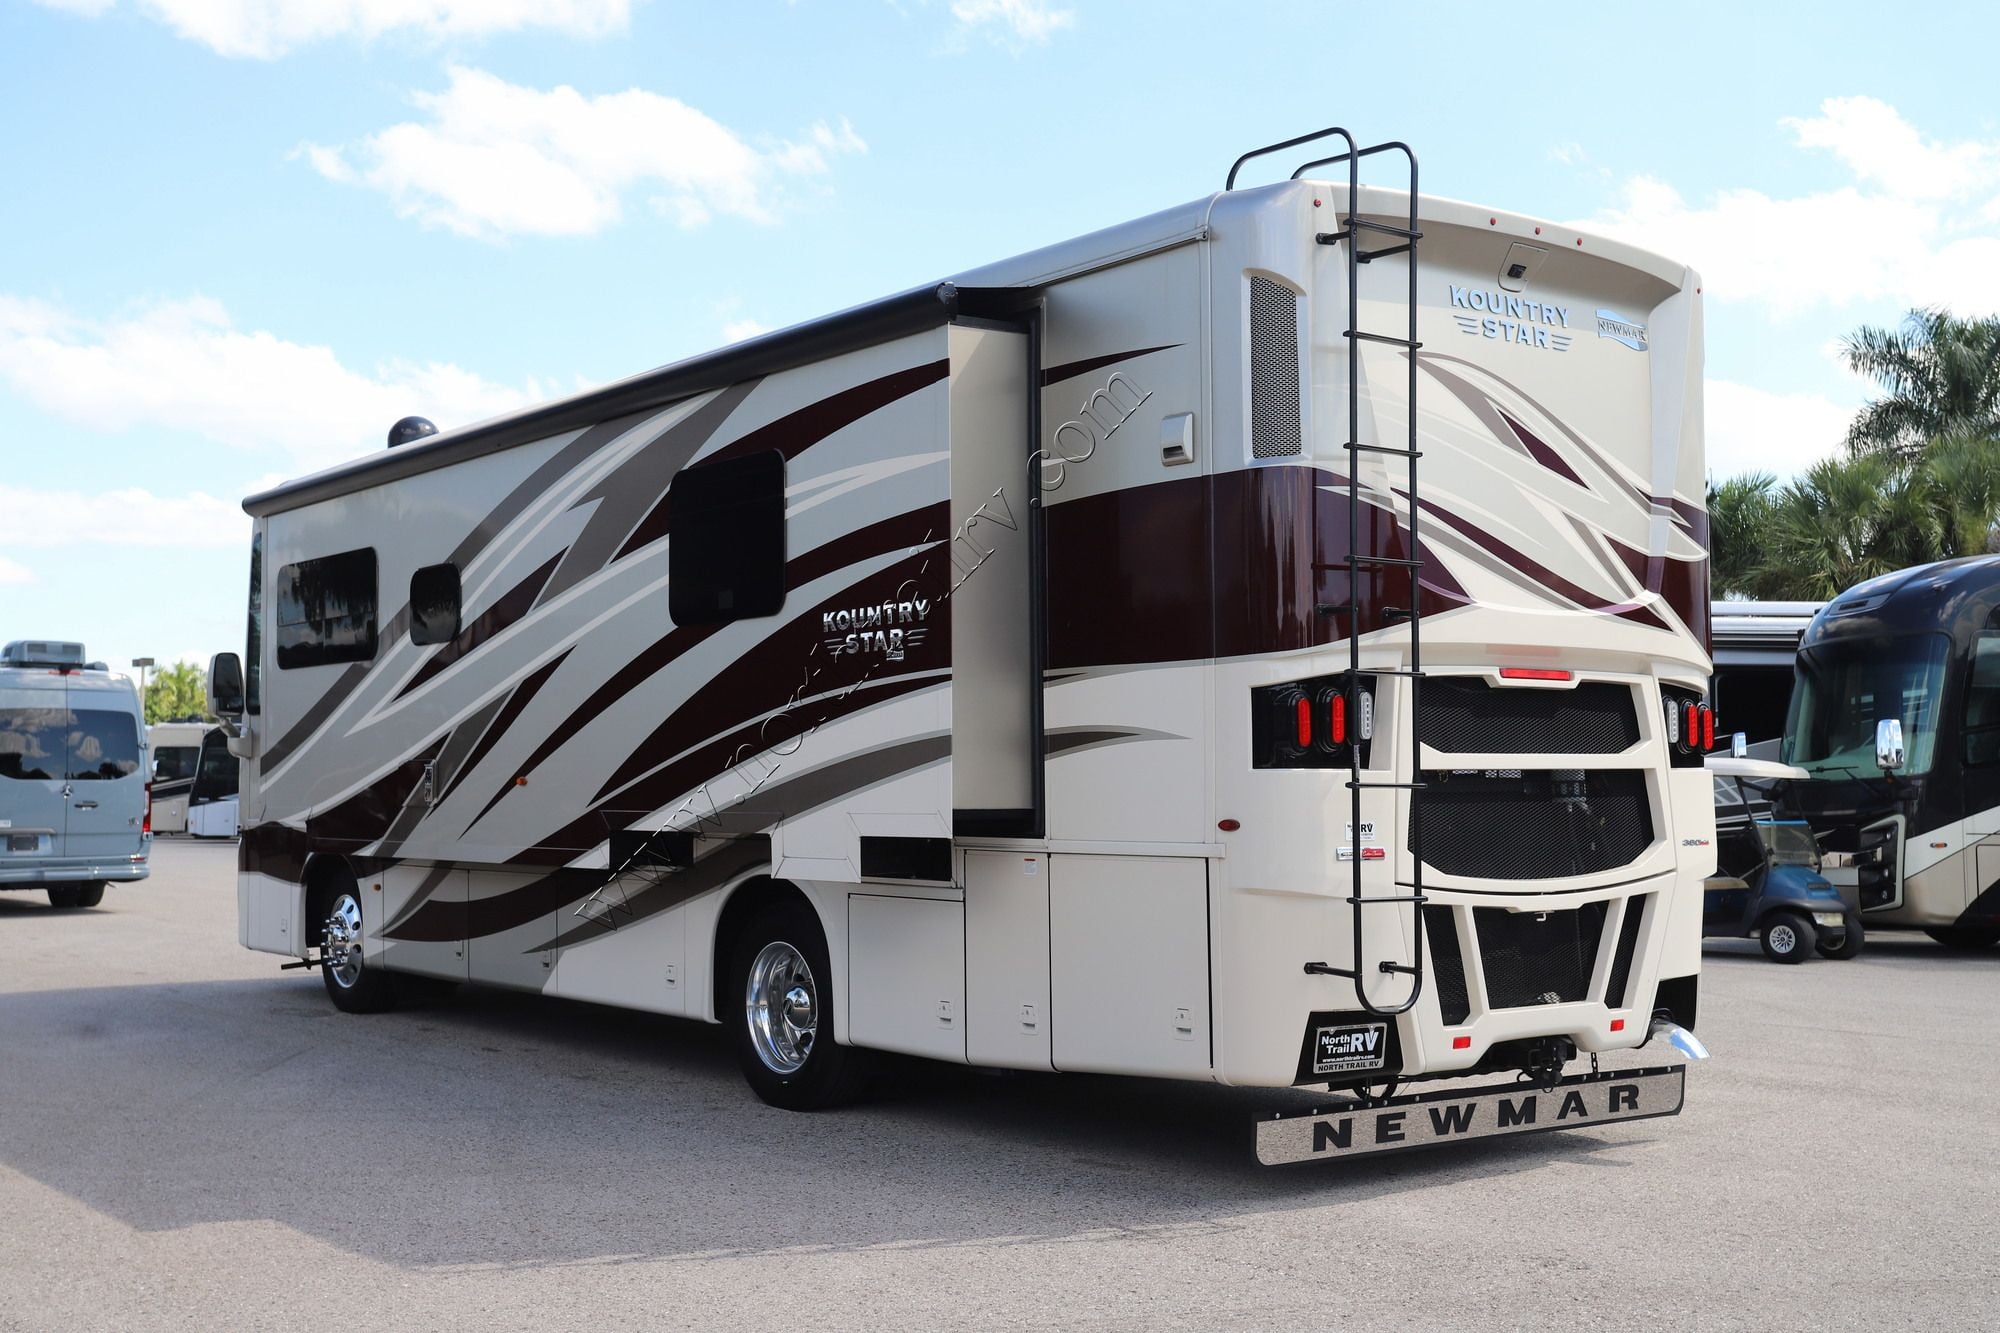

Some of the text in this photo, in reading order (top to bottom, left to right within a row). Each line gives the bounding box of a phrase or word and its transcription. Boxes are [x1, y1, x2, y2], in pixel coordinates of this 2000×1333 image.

[1450, 284, 1569, 328] KOUNTRY
[1482, 316, 1549, 349] STAR
[1599, 320, 1647, 342] NEWMAR
[823, 599, 929, 633] KOUNTRY
[845, 629, 905, 655] STAR
[1321, 1034, 1350, 1045] North
[1326, 1043, 1350, 1055] Trail
[1350, 1031, 1380, 1053] RV
[1318, 1063, 1345, 1072] NORTH
[1346, 1061, 1367, 1069] TRAIL
[1311, 1084, 1640, 1153] NEWMAR
